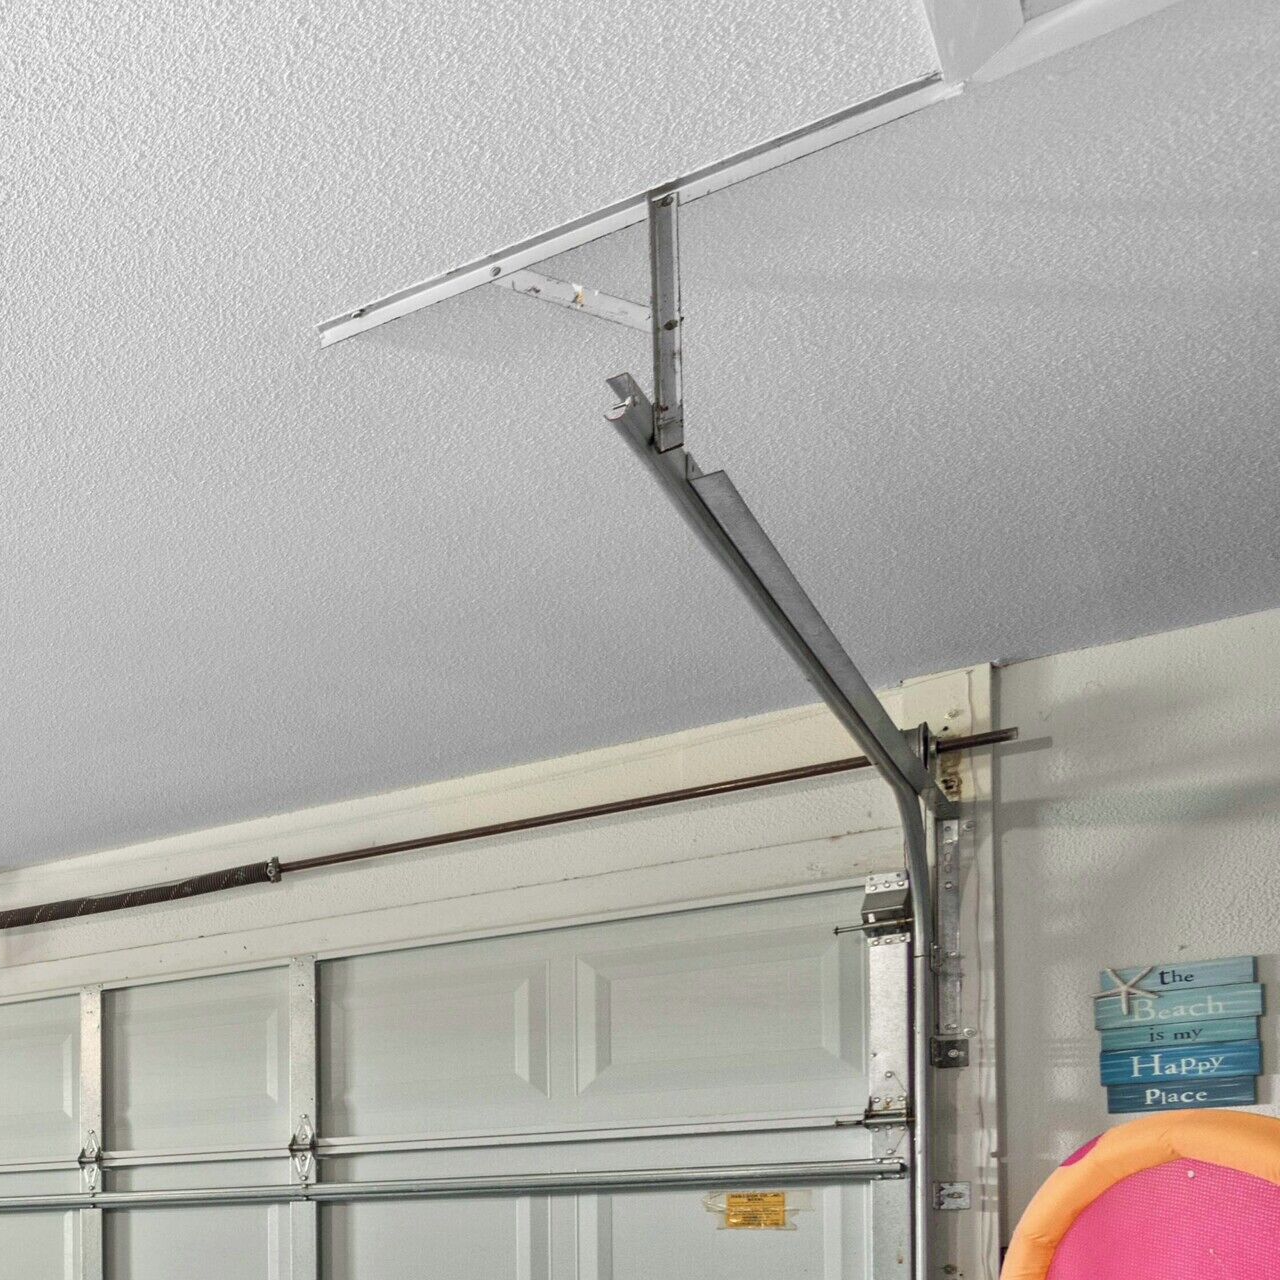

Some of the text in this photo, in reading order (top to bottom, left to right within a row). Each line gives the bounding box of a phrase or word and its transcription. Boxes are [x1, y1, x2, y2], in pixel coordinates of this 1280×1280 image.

[1159, 970, 1195, 985] the
[1132, 995, 1225, 1022] Beach
[1148, 1028, 1203, 1042] is my
[1130, 1054, 1224, 1078] Happy
[1144, 1088, 1208, 1105] Place
